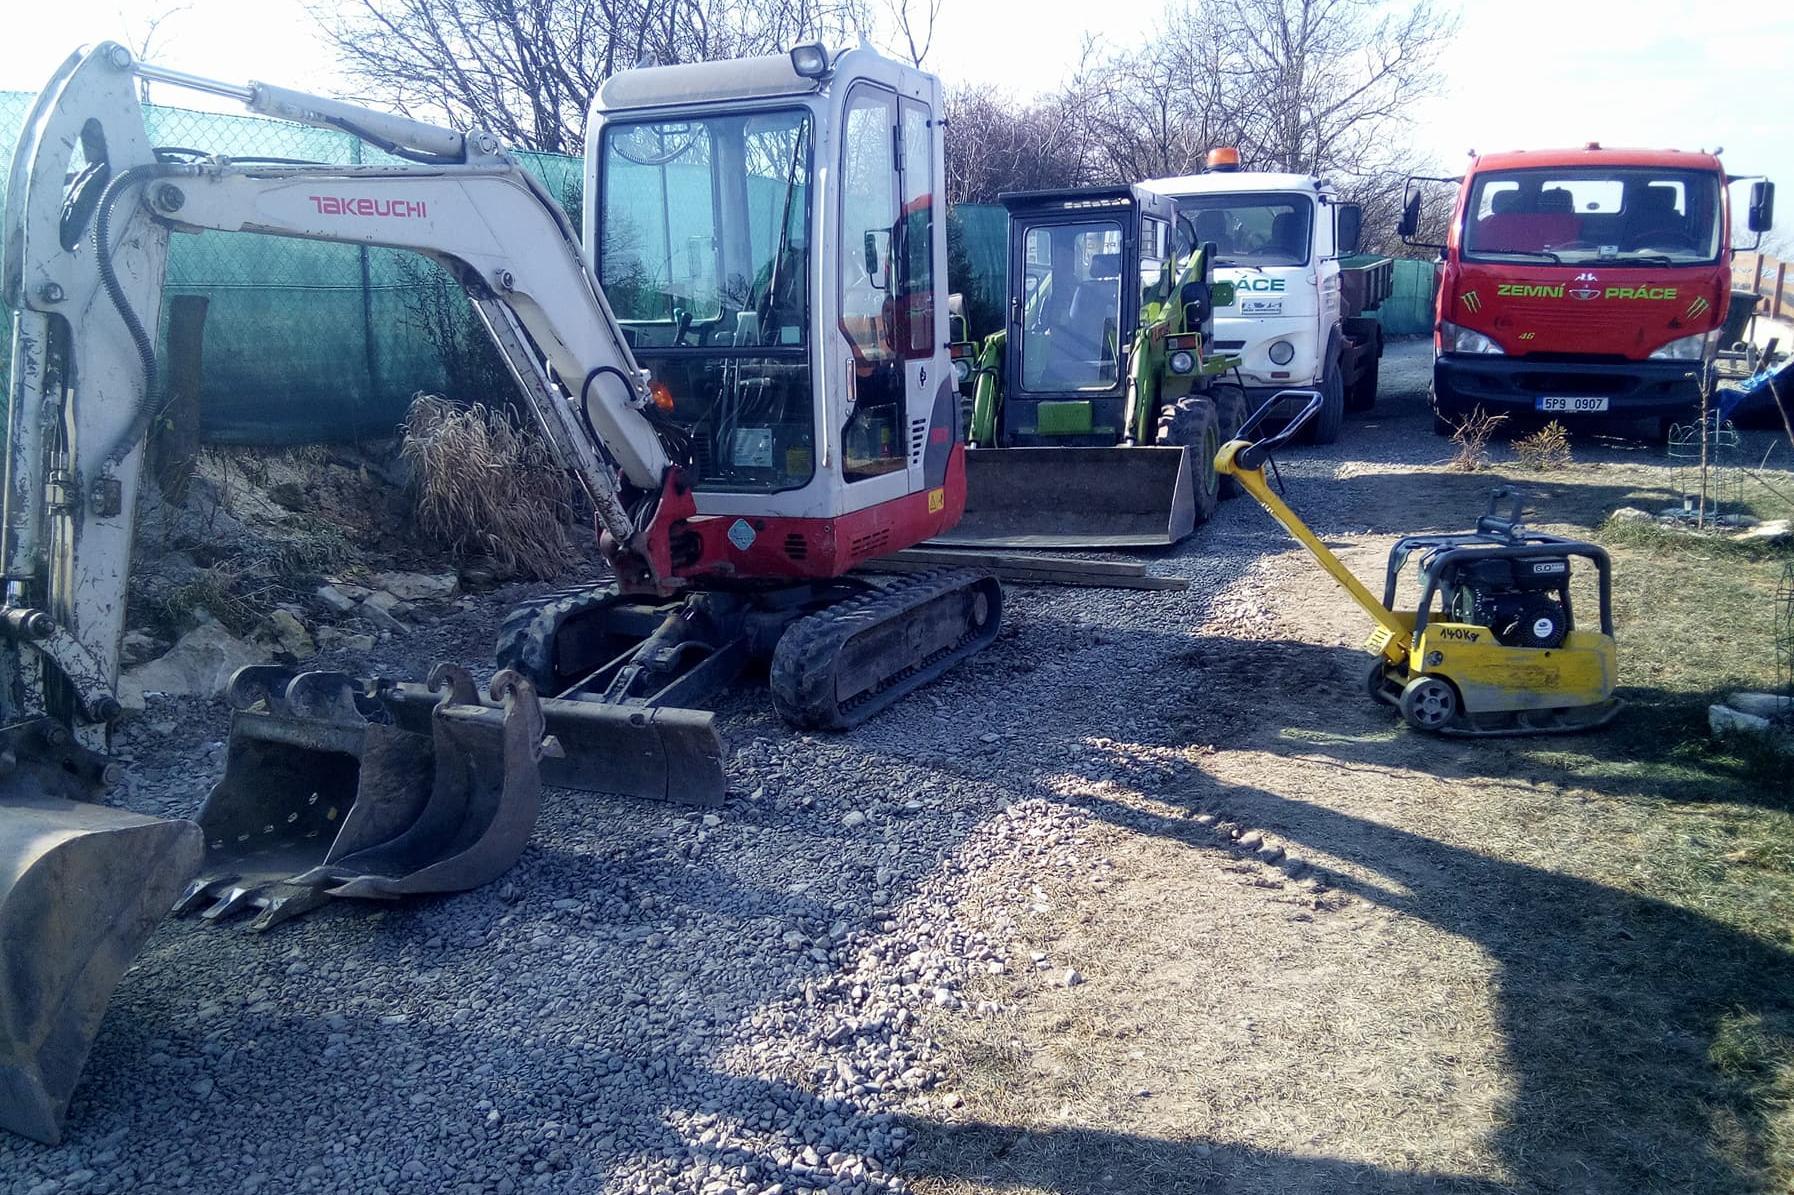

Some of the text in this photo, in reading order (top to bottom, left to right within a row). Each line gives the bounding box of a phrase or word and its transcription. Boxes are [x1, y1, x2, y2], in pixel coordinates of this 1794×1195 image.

[1224, 275, 1286, 292] ÁCE
[1497, 283, 1677, 300] ZEMNÍ PRÁCE
[1545, 398, 1604, 410] 5P9 0907
